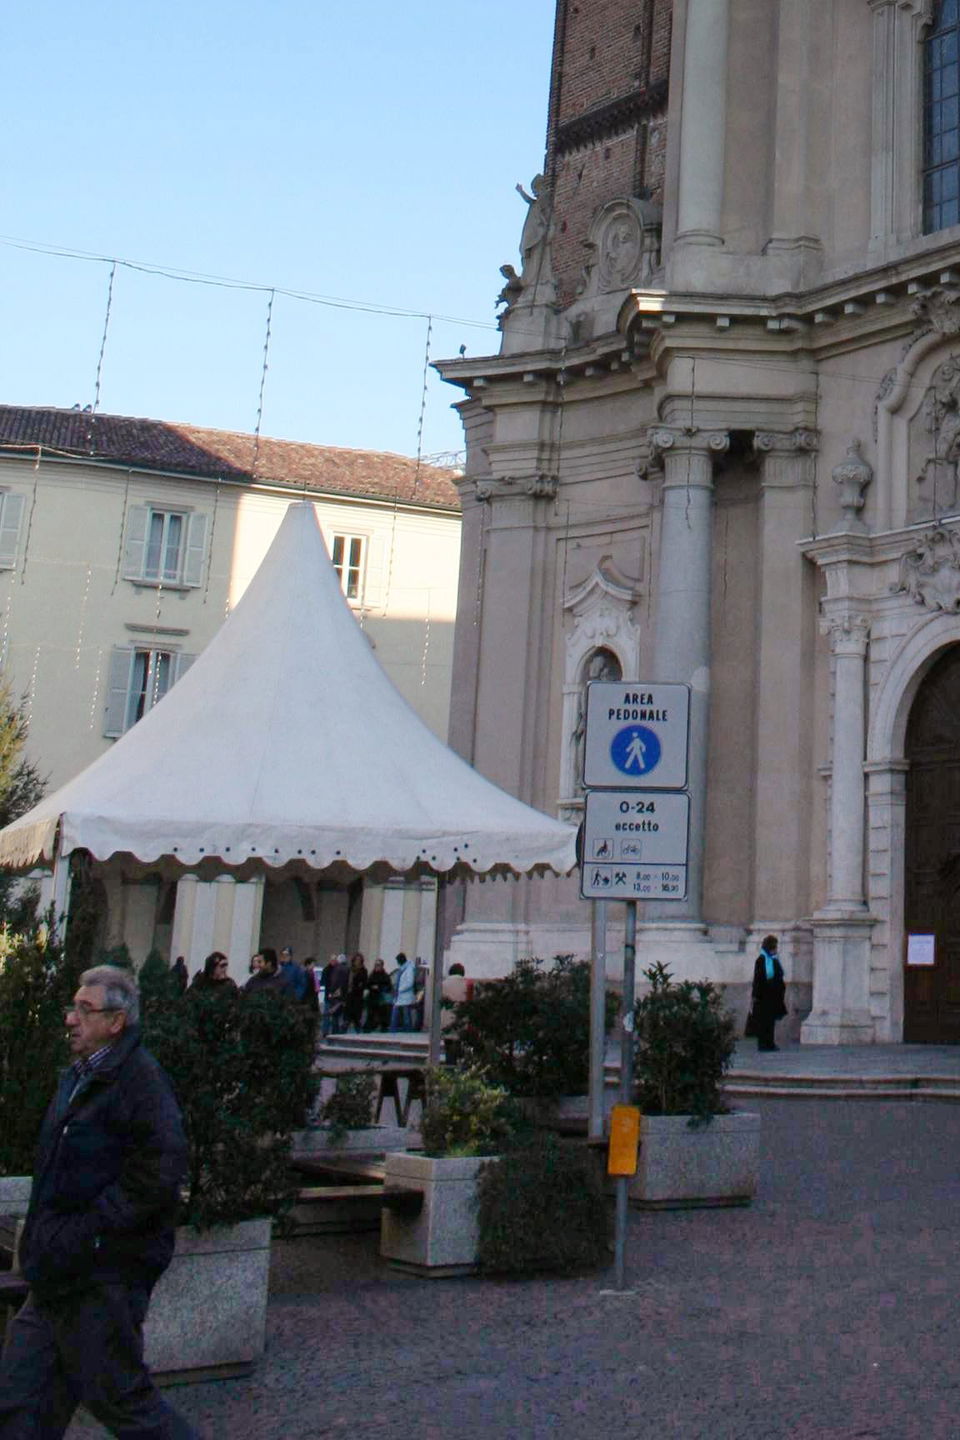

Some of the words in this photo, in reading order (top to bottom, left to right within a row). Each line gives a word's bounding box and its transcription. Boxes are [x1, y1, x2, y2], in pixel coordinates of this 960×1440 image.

[624, 692, 653, 705] AREA
[608, 708, 668, 721] PEDONALE
[620, 801, 655, 813] 0-24
[615, 820, 659, 832] eccetto
